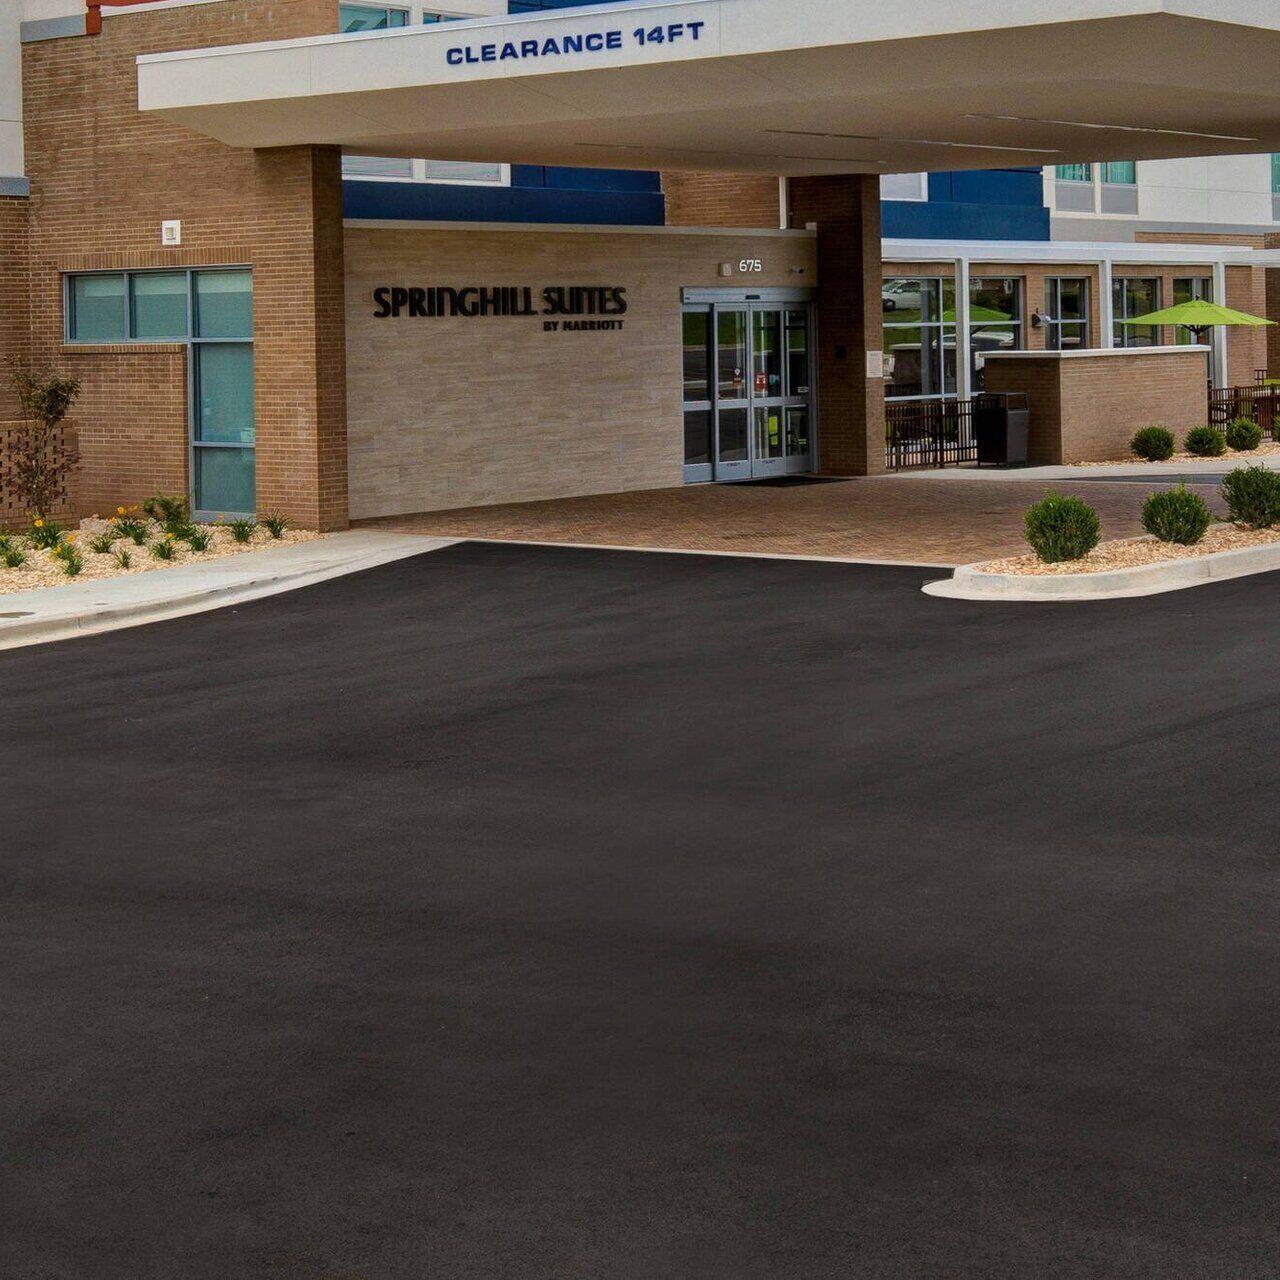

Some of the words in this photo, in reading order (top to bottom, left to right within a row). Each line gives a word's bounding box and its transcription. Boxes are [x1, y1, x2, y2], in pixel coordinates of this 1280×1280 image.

[446, 30, 622, 65] CLEARANCE
[632, 21, 704, 46] 14FT
[739, 259, 762, 272] 675
[373, 286, 538, 318] SPRINGHILL
[542, 286, 627, 315] SUITES
[543, 321, 559, 332] BY
[563, 320, 624, 331] MARRIOTT
